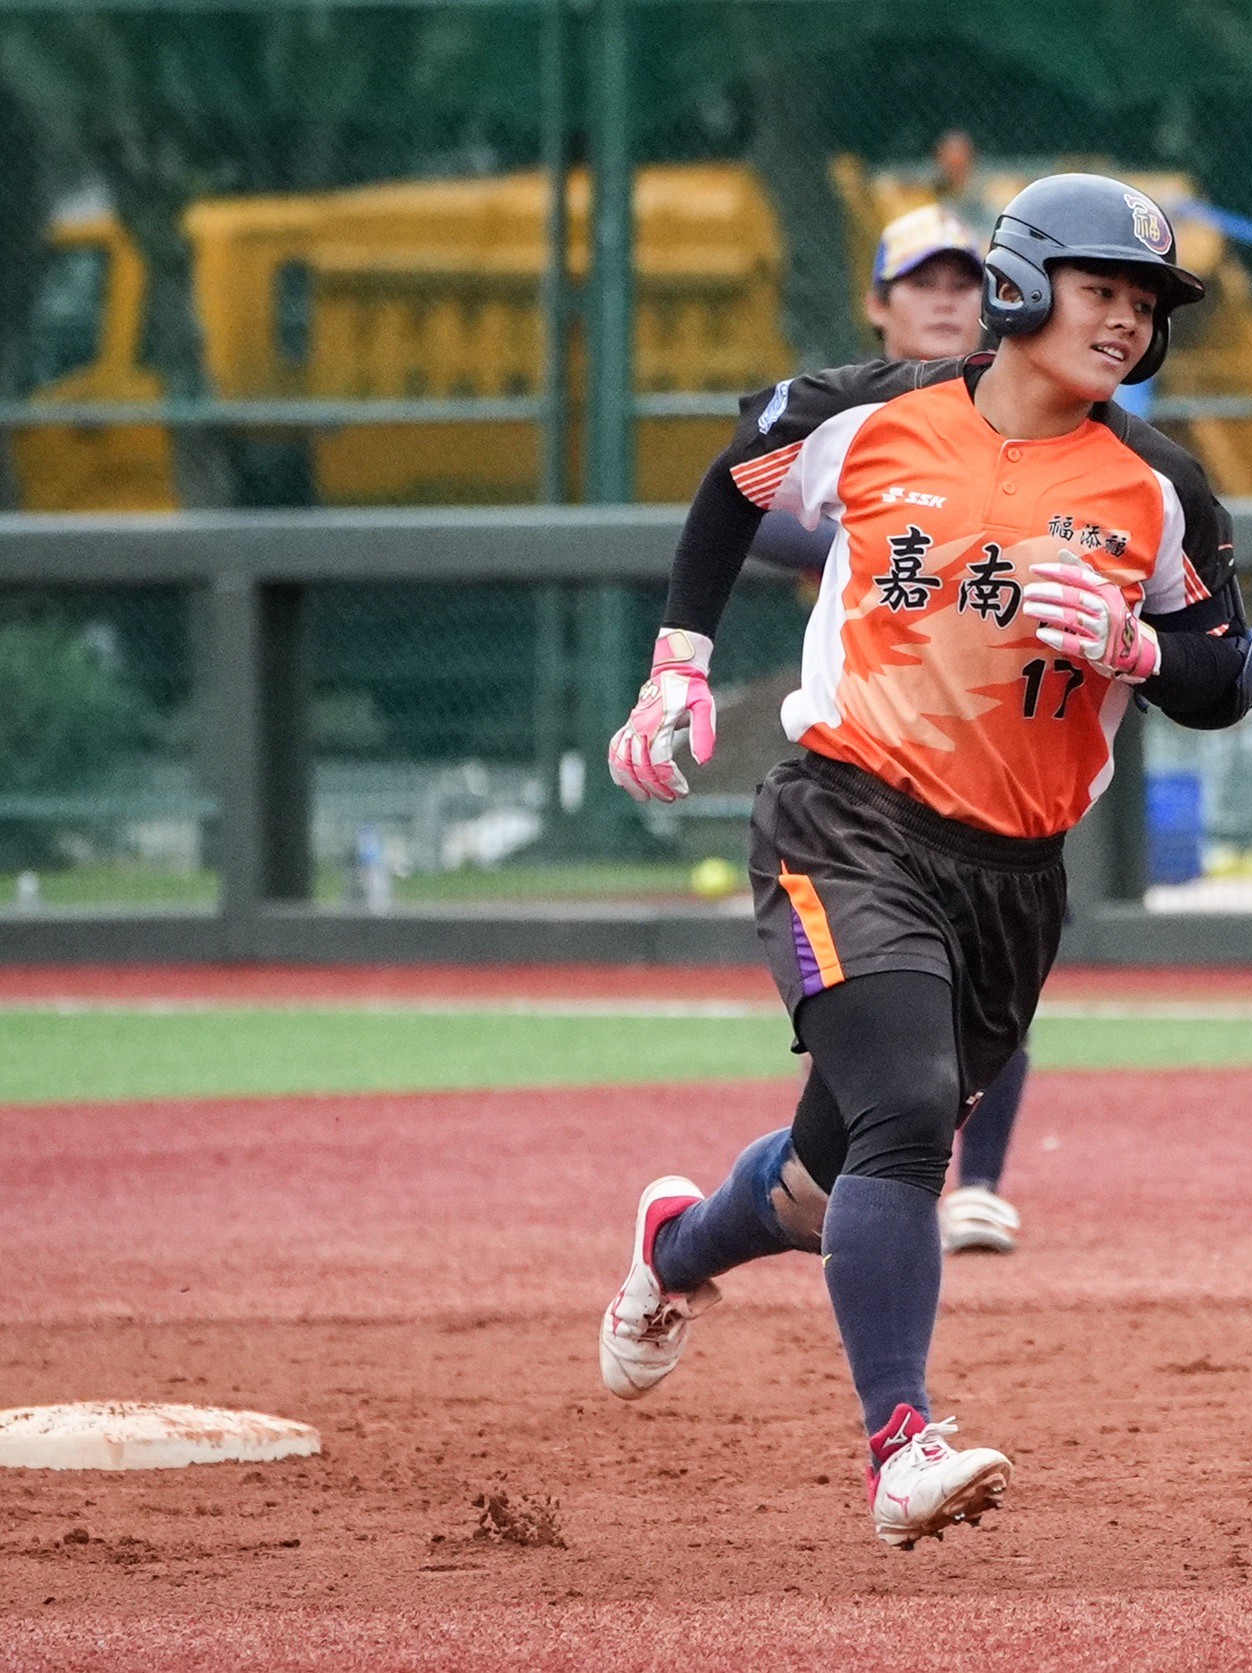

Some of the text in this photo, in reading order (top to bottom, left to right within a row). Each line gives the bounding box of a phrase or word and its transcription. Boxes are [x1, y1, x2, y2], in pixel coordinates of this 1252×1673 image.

[904, 491, 948, 509] SSK
[873, 525, 1077, 636] 嘉南
[1022, 657, 1084, 719] 17
